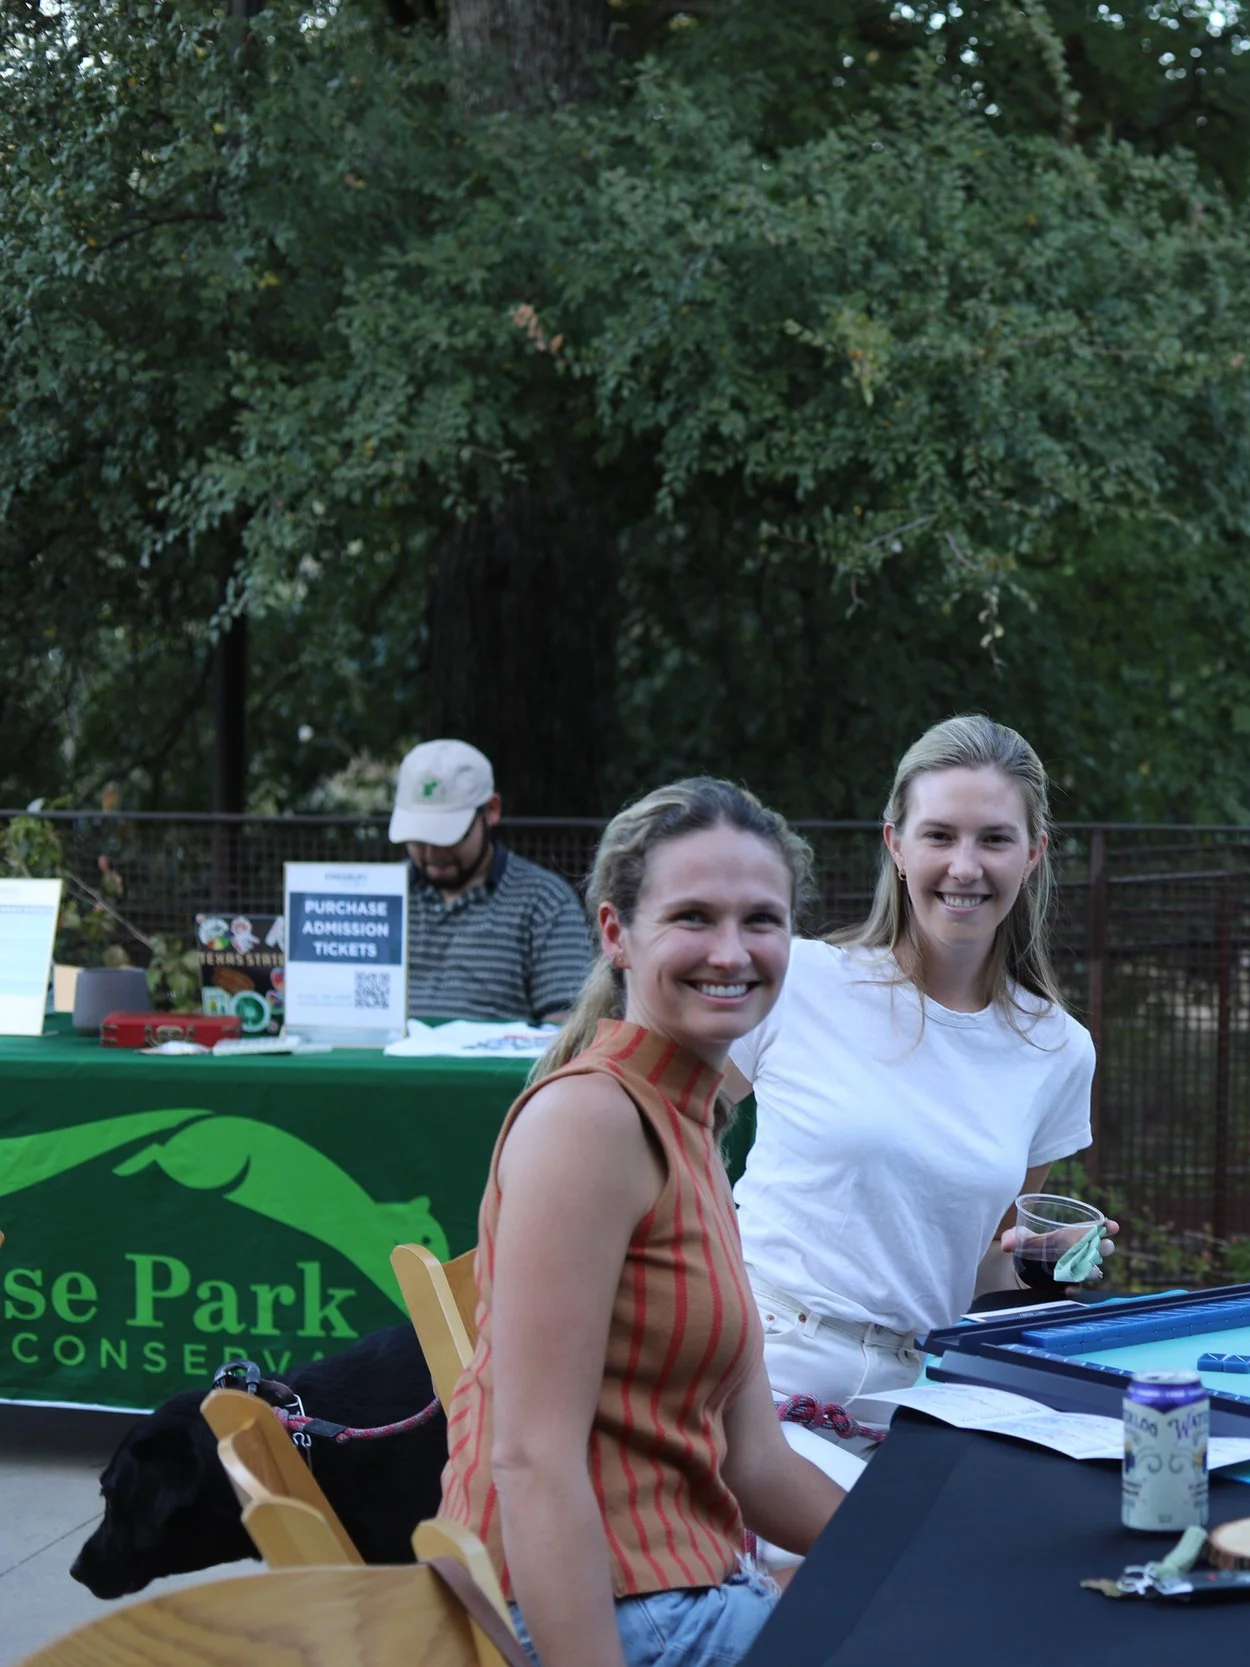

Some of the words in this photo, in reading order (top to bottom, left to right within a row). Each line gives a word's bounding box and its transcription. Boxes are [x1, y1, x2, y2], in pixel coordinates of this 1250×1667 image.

[304, 900, 388, 917] PURCHASE
[302, 919, 390, 938] ADMISSION
[313, 941, 378, 958] TICKETS
[125, 1253, 358, 1339] Park
